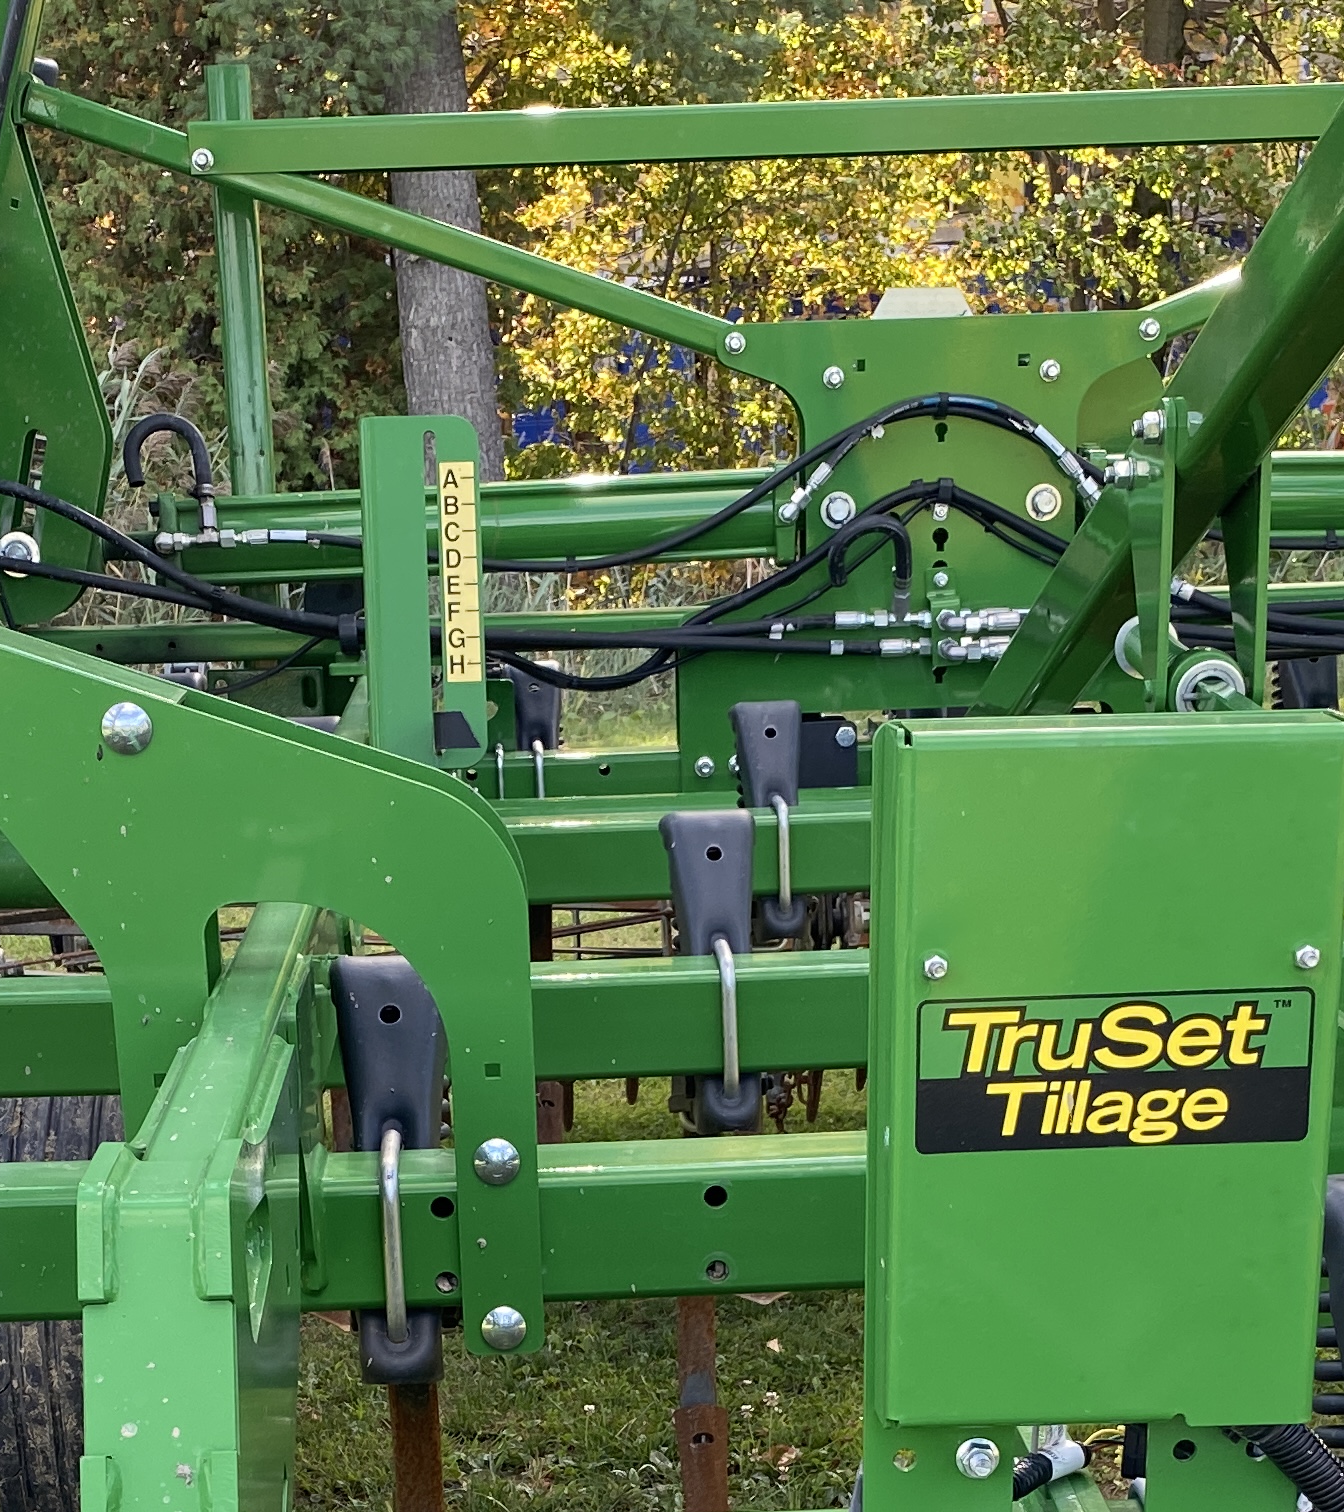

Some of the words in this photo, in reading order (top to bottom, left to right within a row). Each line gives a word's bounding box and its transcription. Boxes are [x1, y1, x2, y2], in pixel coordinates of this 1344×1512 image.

[443, 469, 458, 489] A
[444, 496, 459, 515] B
[444, 522, 460, 542] C
[446, 549, 461, 568] D
[447, 575, 461, 595] E
[448, 602, 460, 621] F
[448, 628, 465, 648] G
[450, 655, 464, 674] H
[946, 1001, 1268, 1075] TruSet
[985, 1078, 1230, 1145] Tillage
